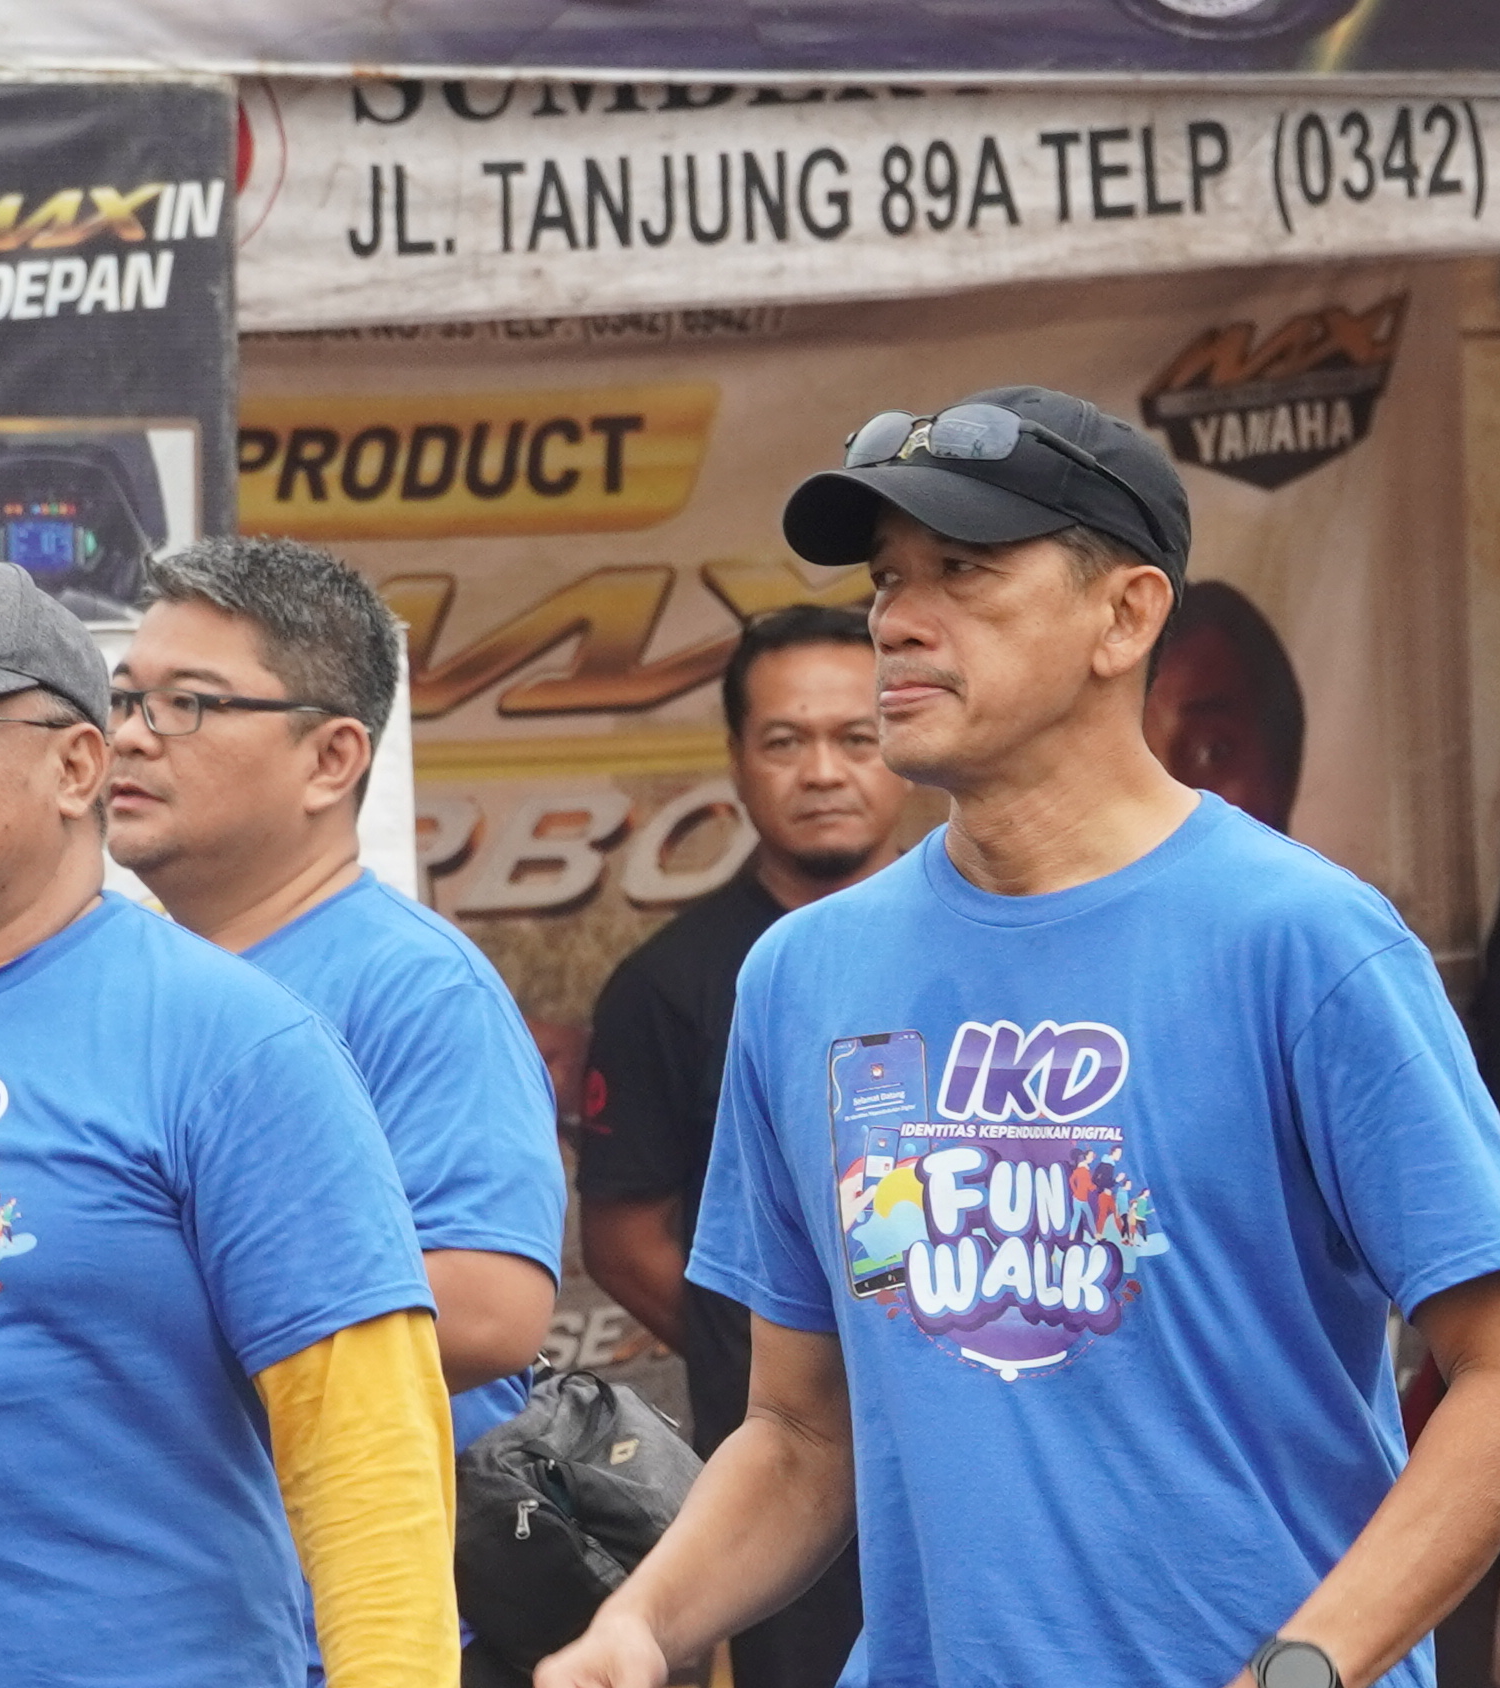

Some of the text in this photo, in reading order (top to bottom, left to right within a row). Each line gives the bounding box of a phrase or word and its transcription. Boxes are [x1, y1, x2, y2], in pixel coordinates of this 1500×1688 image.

[348, 163, 457, 258] JL.
[482, 147, 852, 253] TANJUNG
[880, 136, 1020, 237] 89A
[1040, 120, 1230, 222] TELP
[1273, 98, 1487, 233] (0342)
[238, 413, 647, 502] PRODUCT
[1193, 401, 1354, 464] YAMAHA
[936, 1019, 1130, 1122] IKD
[901, 1123, 1123, 1141] IDENTITAS KEPENDUDUKAN DIGITAL
[923, 1146, 1070, 1237] FUN
[909, 1235, 1112, 1316] WALK
